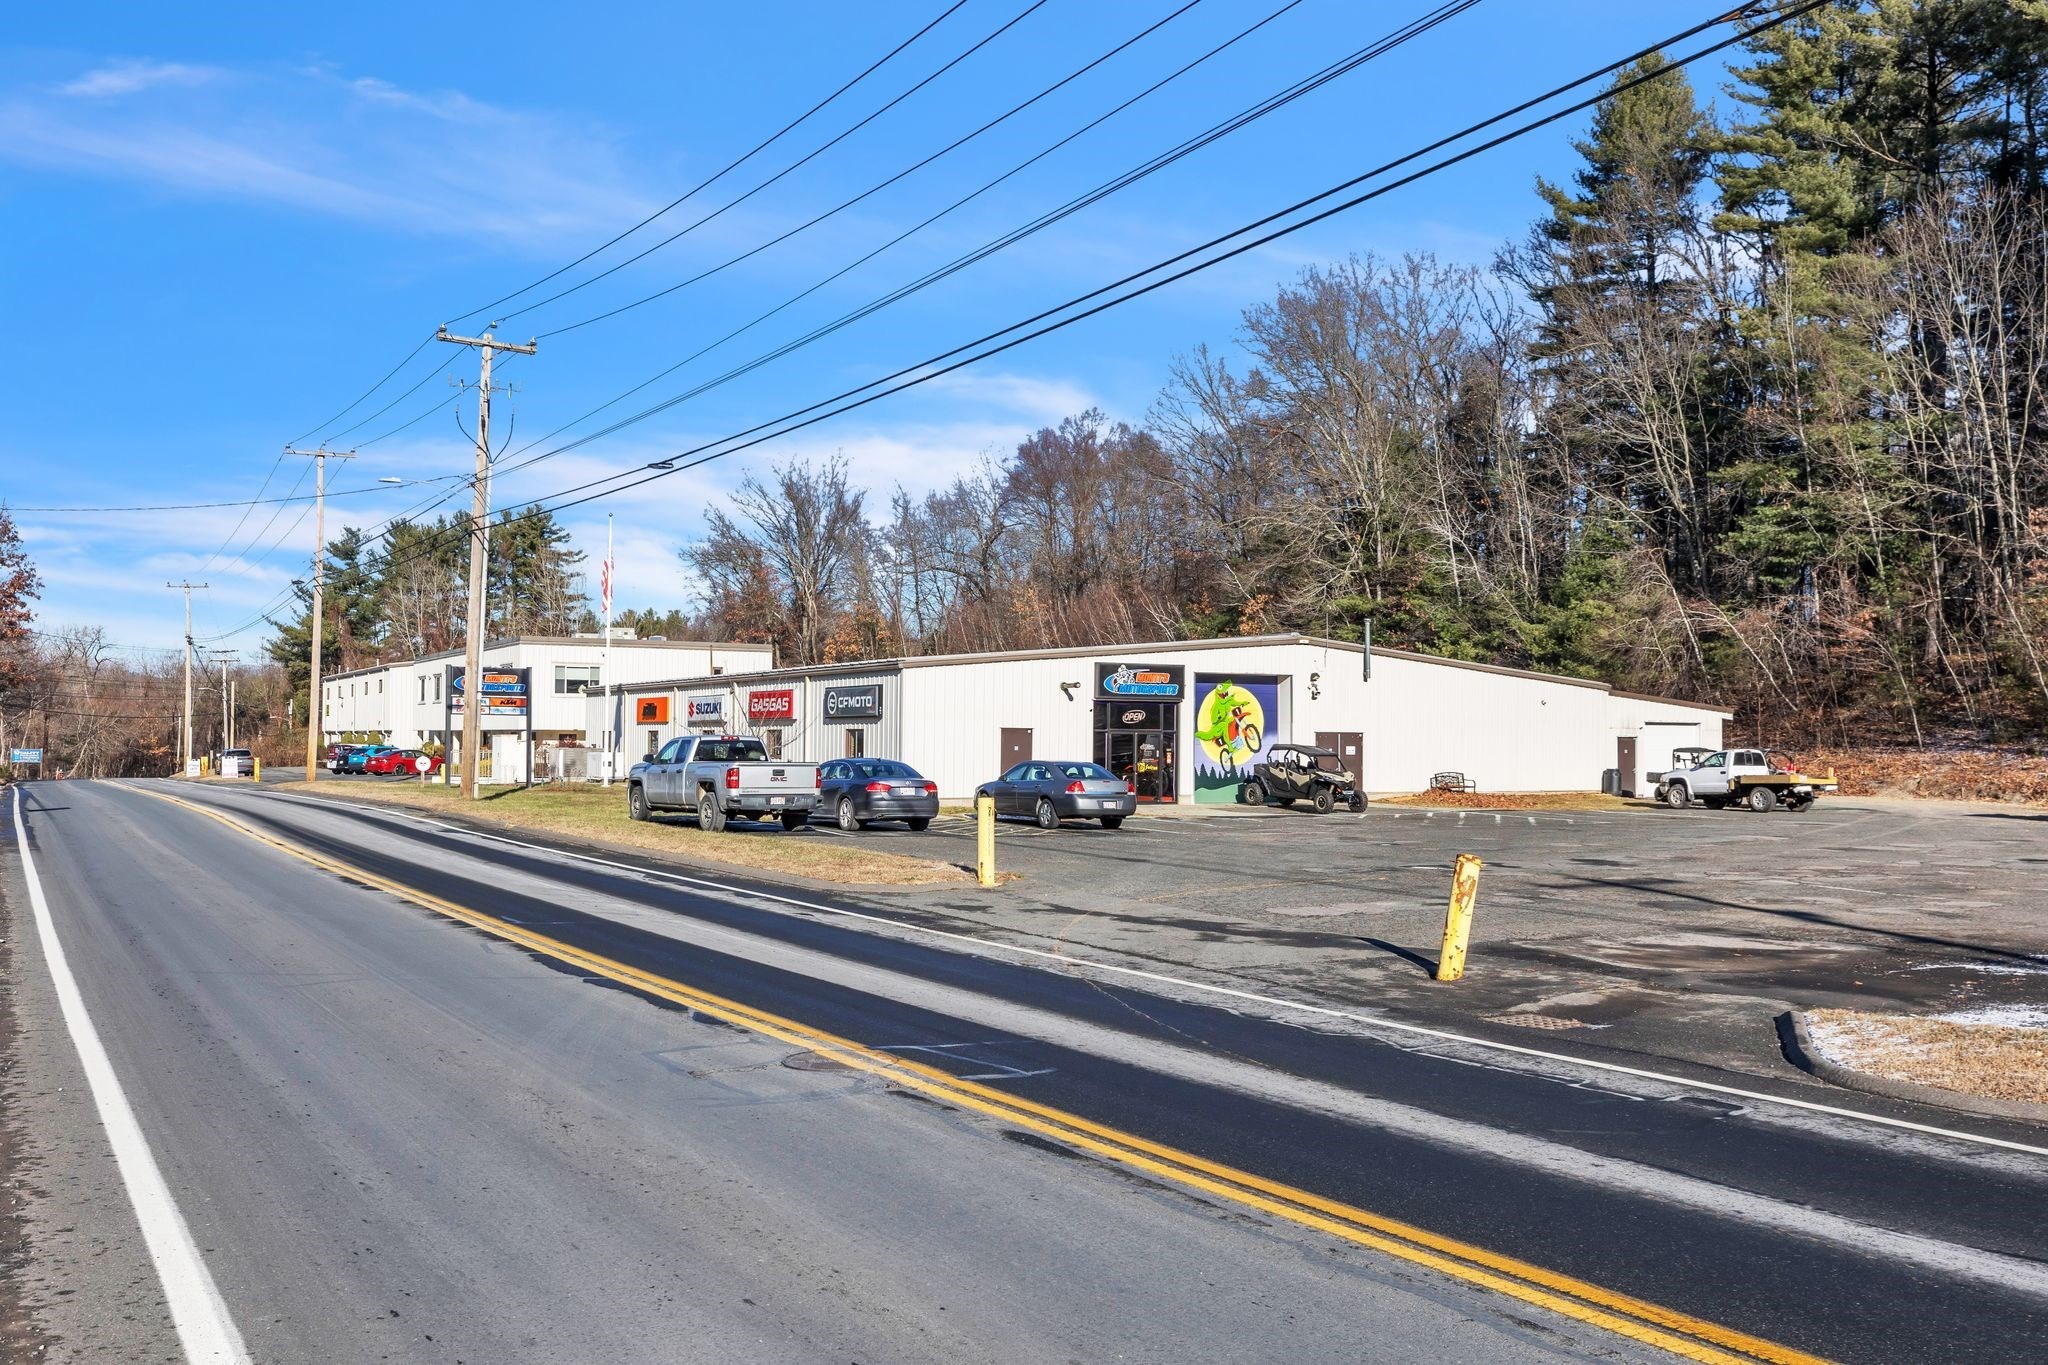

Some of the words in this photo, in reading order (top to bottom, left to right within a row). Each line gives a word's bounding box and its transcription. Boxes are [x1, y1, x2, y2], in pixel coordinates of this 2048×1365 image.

[751, 698, 789, 711] GASGAS
[838, 696, 873, 708] CFMOTO
[695, 702, 722, 715] SUZUKI
[1124, 713, 1143, 721] OPEN
